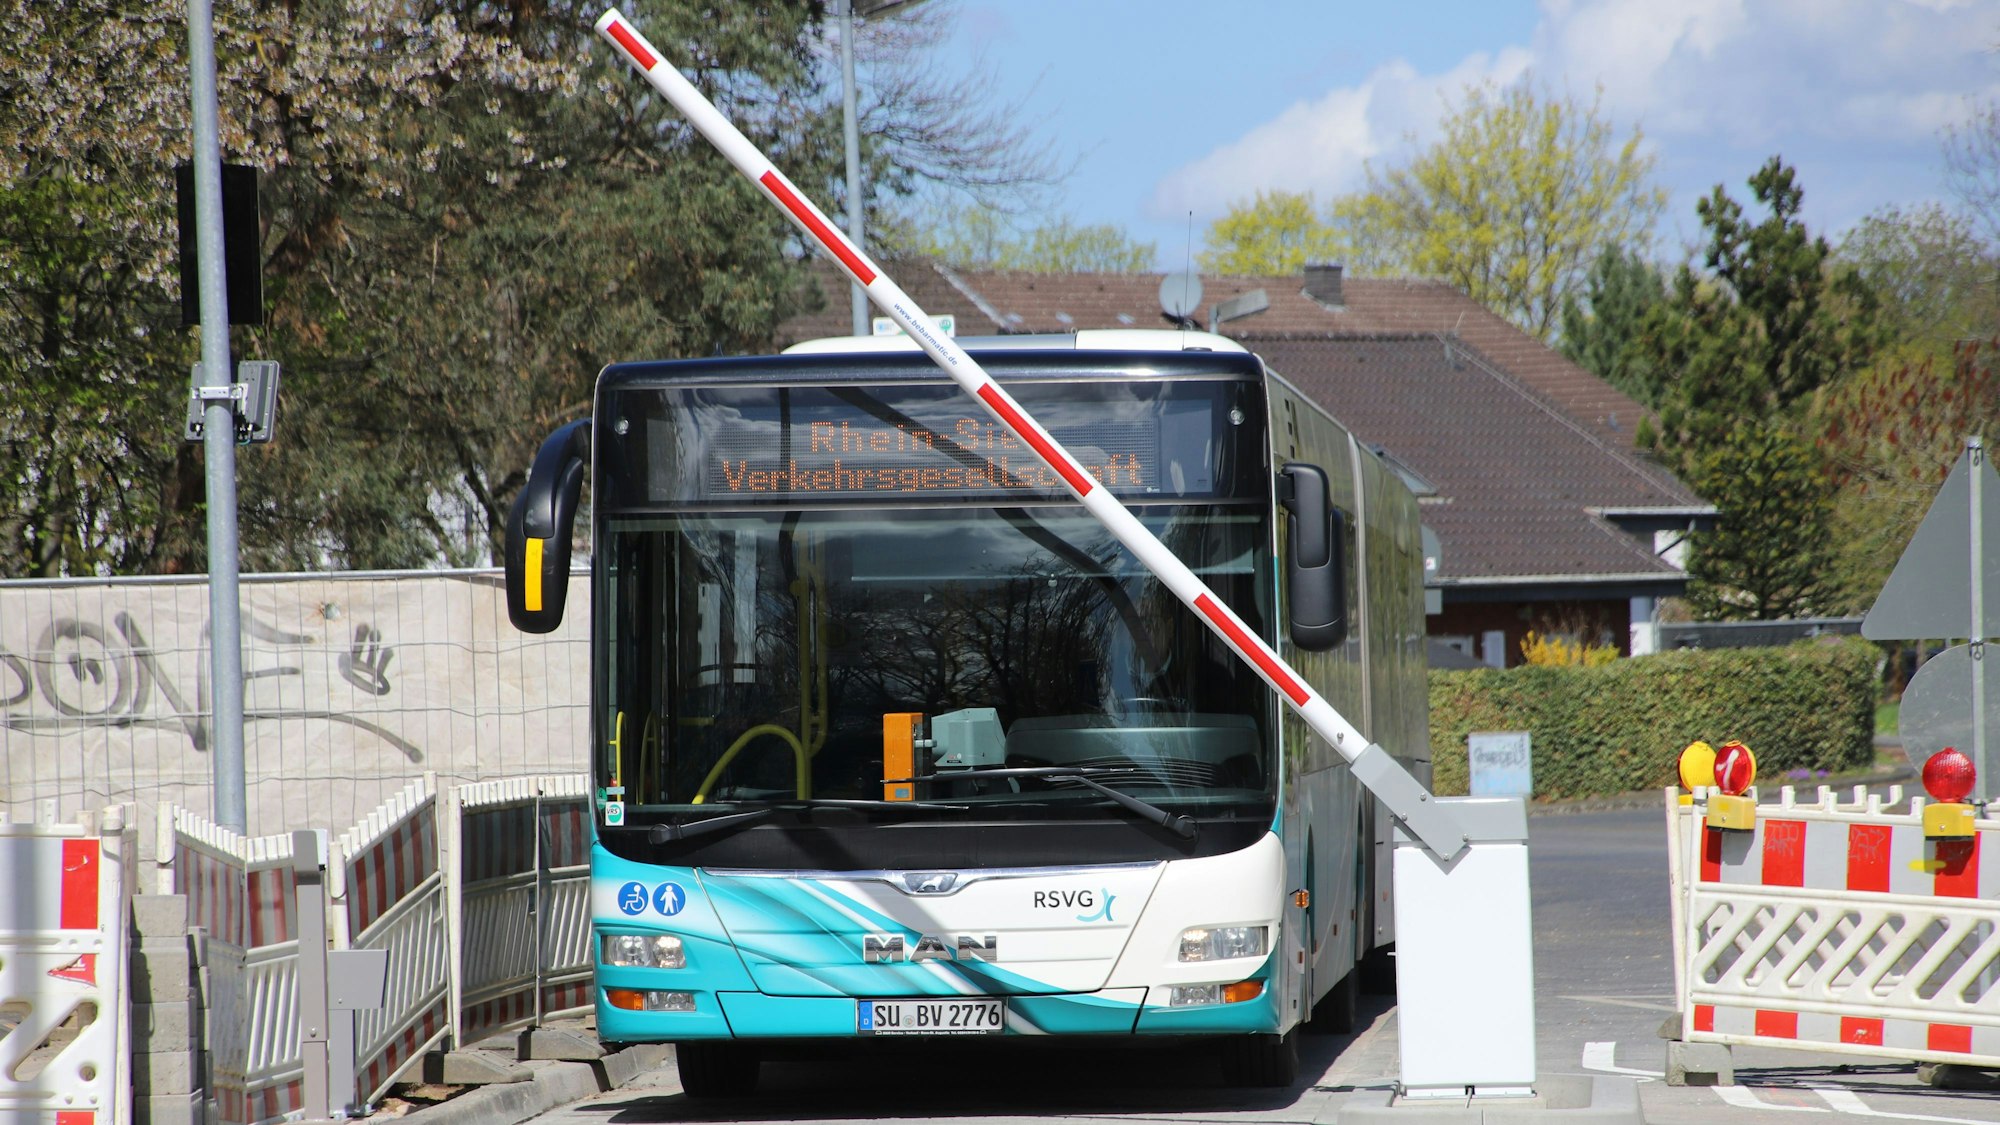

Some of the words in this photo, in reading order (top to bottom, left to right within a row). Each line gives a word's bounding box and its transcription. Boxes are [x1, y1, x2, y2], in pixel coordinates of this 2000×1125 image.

[893, 303, 959, 367] www.bebarmatic.de
[811, 418, 1019, 452] Rhein-Sie
[722, 453, 1142, 492] Verkehrsgesellscaft
[1034, 889, 1093, 908] RSVG
[863, 934, 998, 963] MAN
[863, 1018, 870, 1026] D
[874, 1004, 900, 1027] SU
[916, 1004, 943, 1027] BV
[948, 1004, 1000, 1027] 2776
